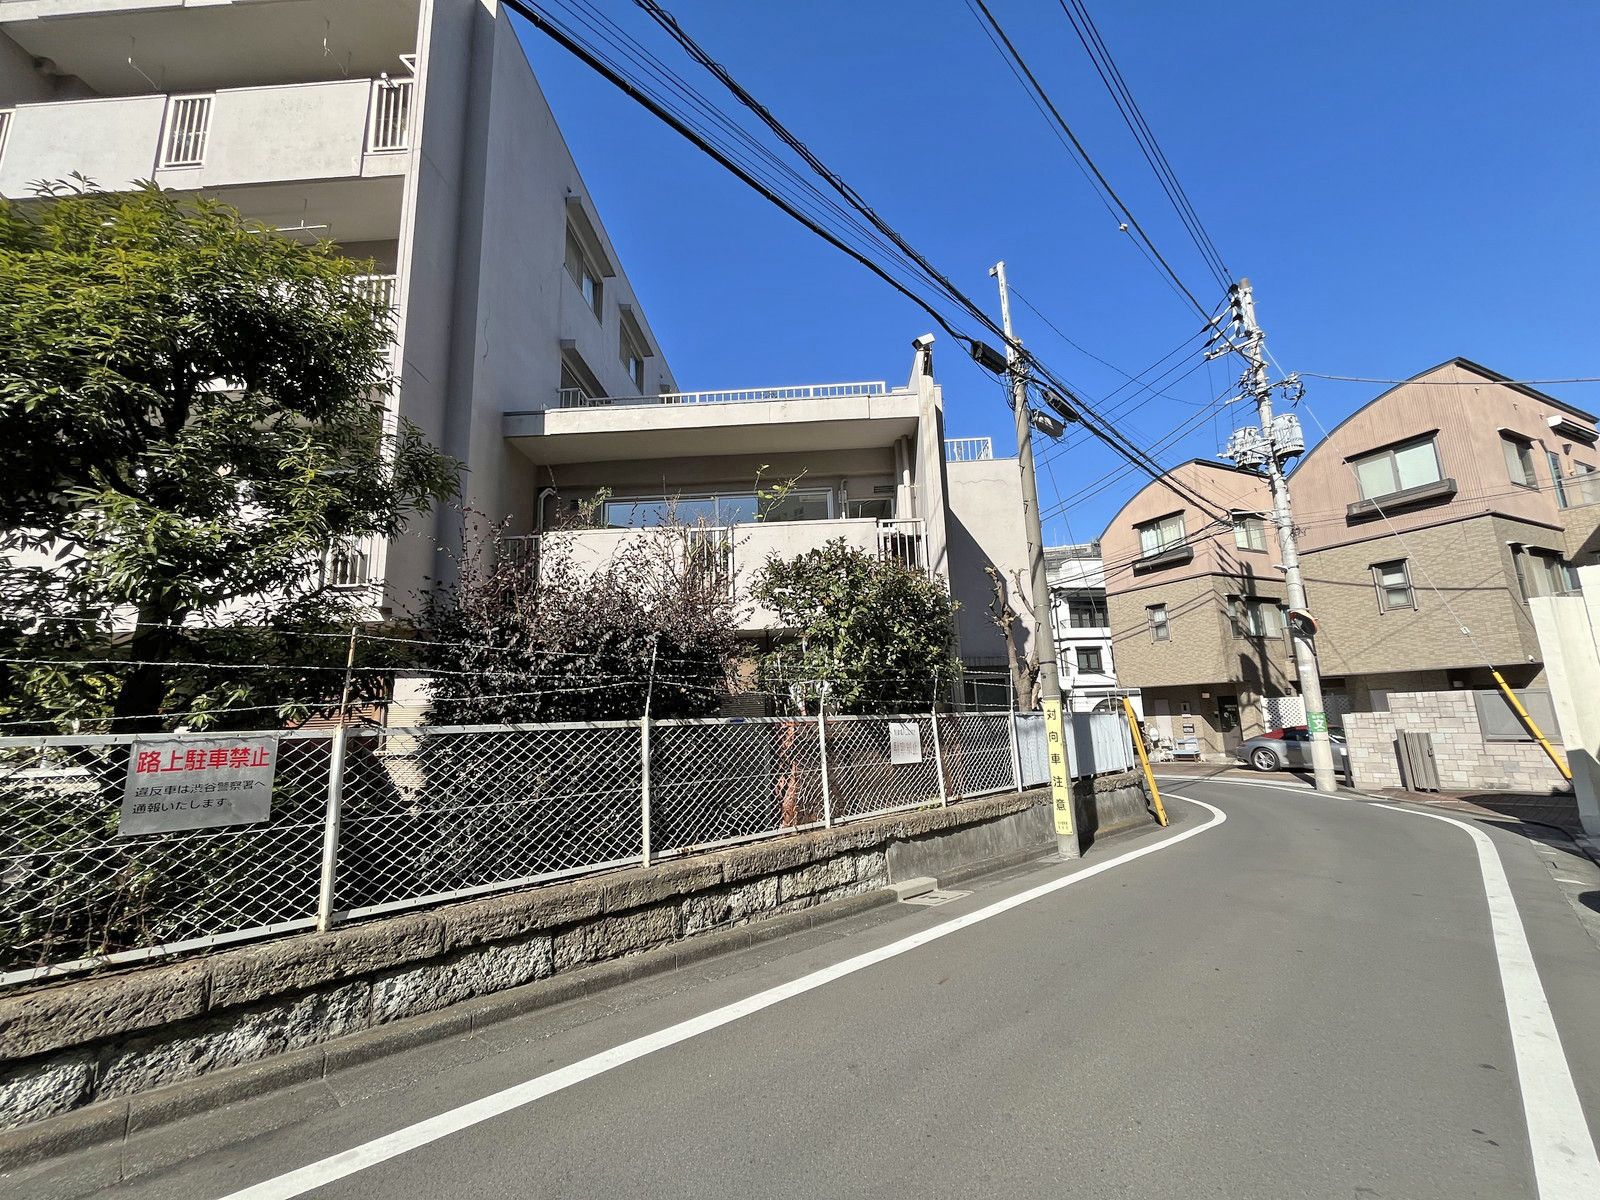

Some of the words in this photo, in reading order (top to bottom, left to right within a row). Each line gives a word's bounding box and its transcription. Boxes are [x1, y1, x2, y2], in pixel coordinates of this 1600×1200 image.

[136, 746, 270, 774] 路上駐車禁止
[1046, 708, 1067, 811] 対向車注意
[134, 780, 266, 798] 違反車は渋谷警察署へ
[132, 798, 233, 815] 通報いたします。
